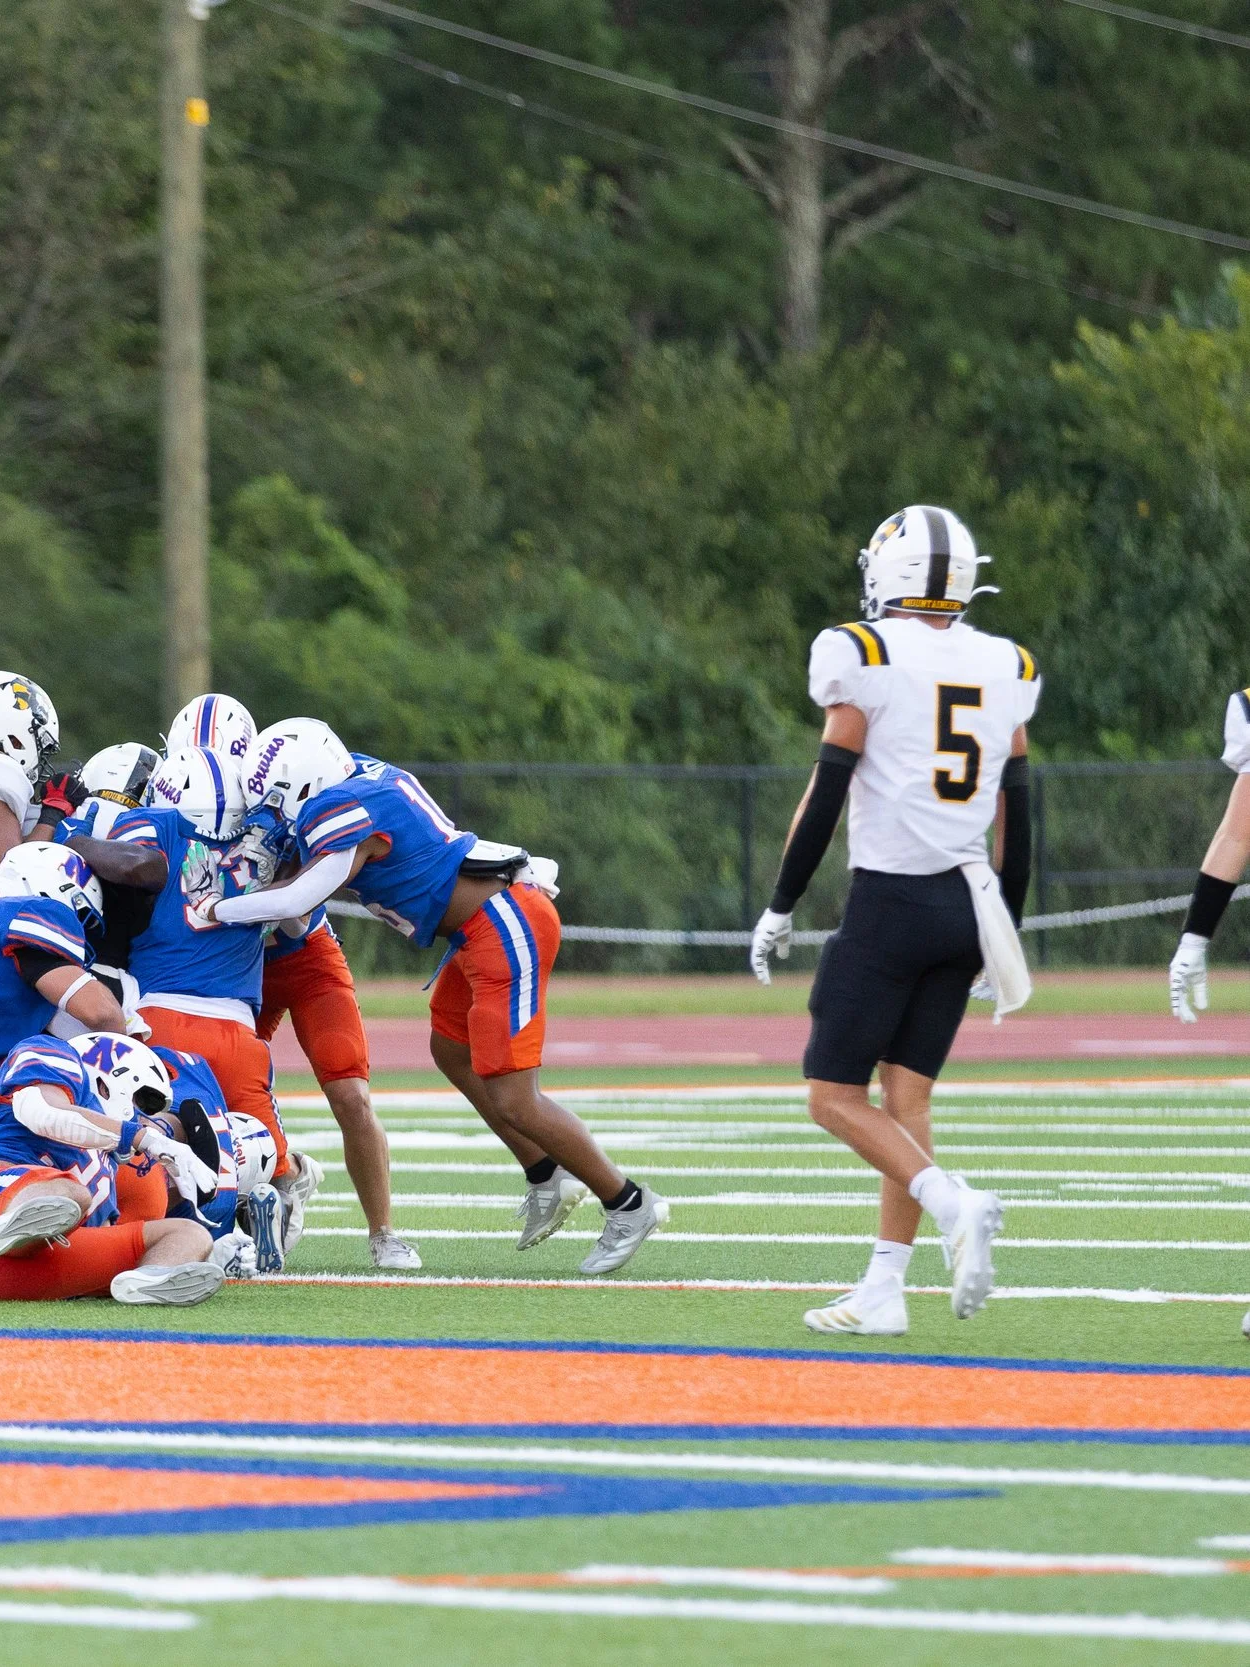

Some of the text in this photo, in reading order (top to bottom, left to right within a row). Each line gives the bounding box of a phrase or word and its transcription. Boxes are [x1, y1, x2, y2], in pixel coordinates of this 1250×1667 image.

[901, 598, 962, 611] MOUNTAINEERS
[247, 737, 285, 796] Bruins
[934, 682, 983, 804] 5
